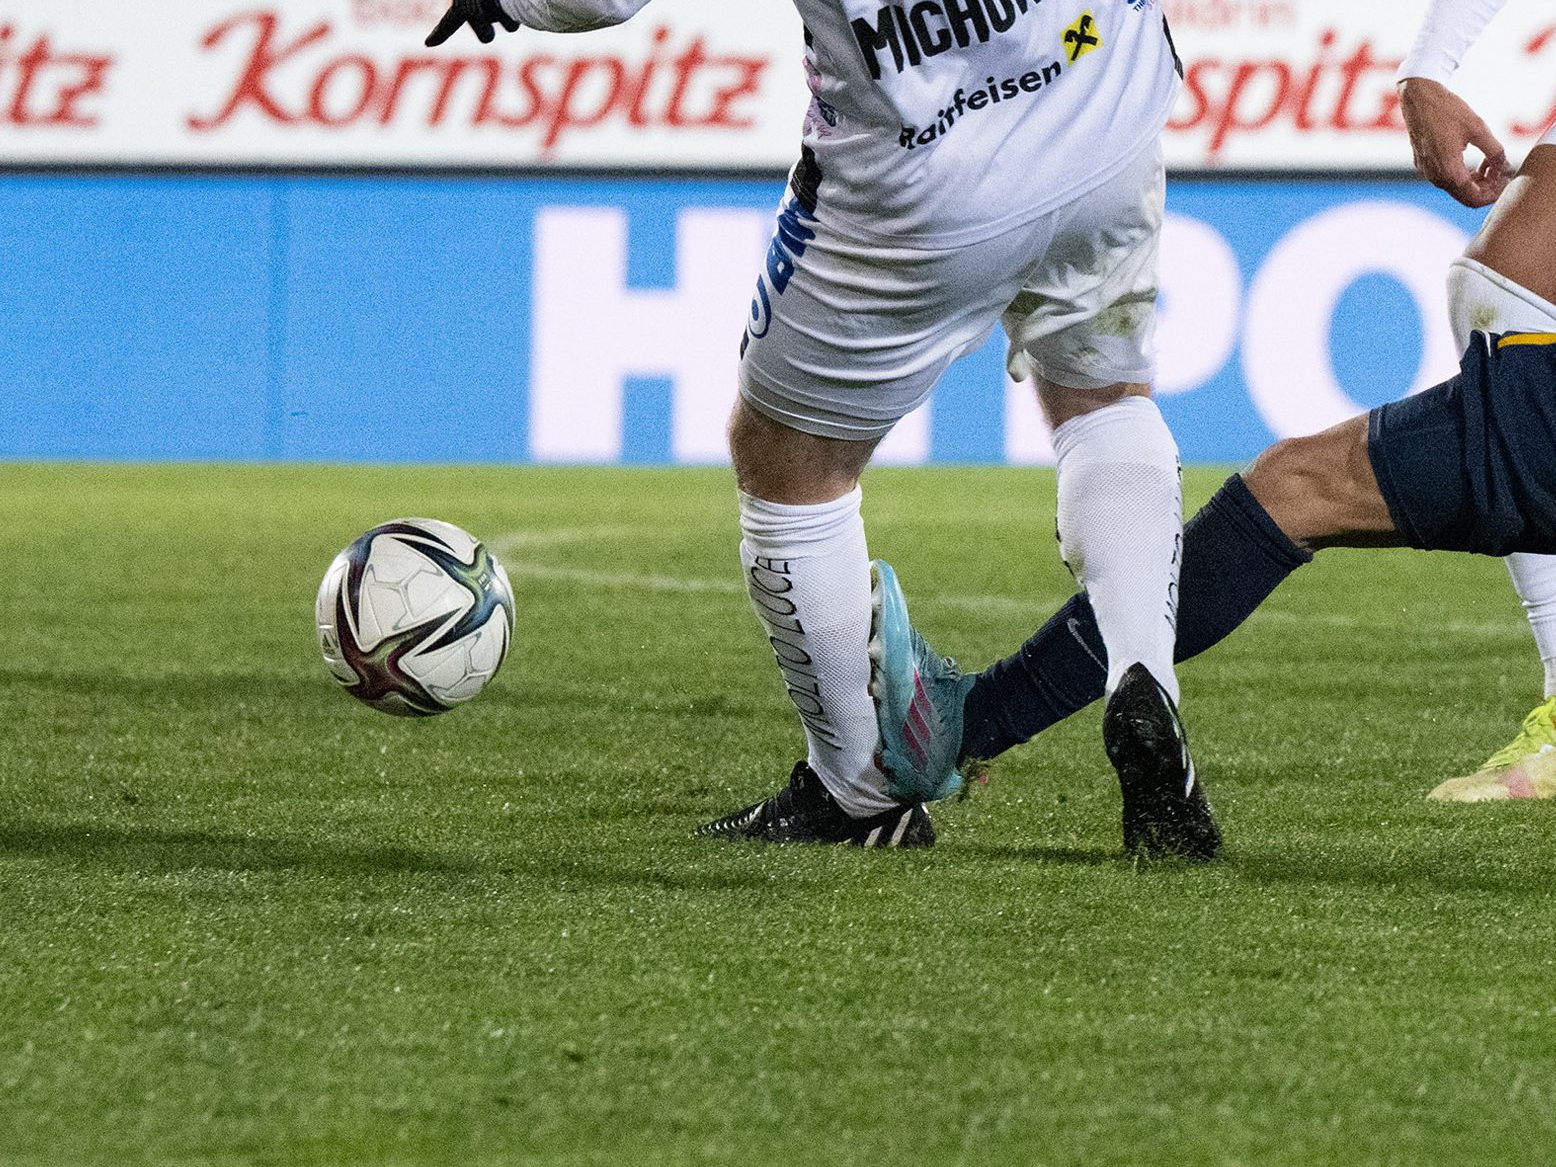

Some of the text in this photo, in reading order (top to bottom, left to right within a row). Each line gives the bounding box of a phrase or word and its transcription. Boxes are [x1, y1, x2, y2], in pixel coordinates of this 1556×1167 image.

[187, 10, 769, 158] Kornspitz
[750, 555, 843, 750] MOLTO LUCE
